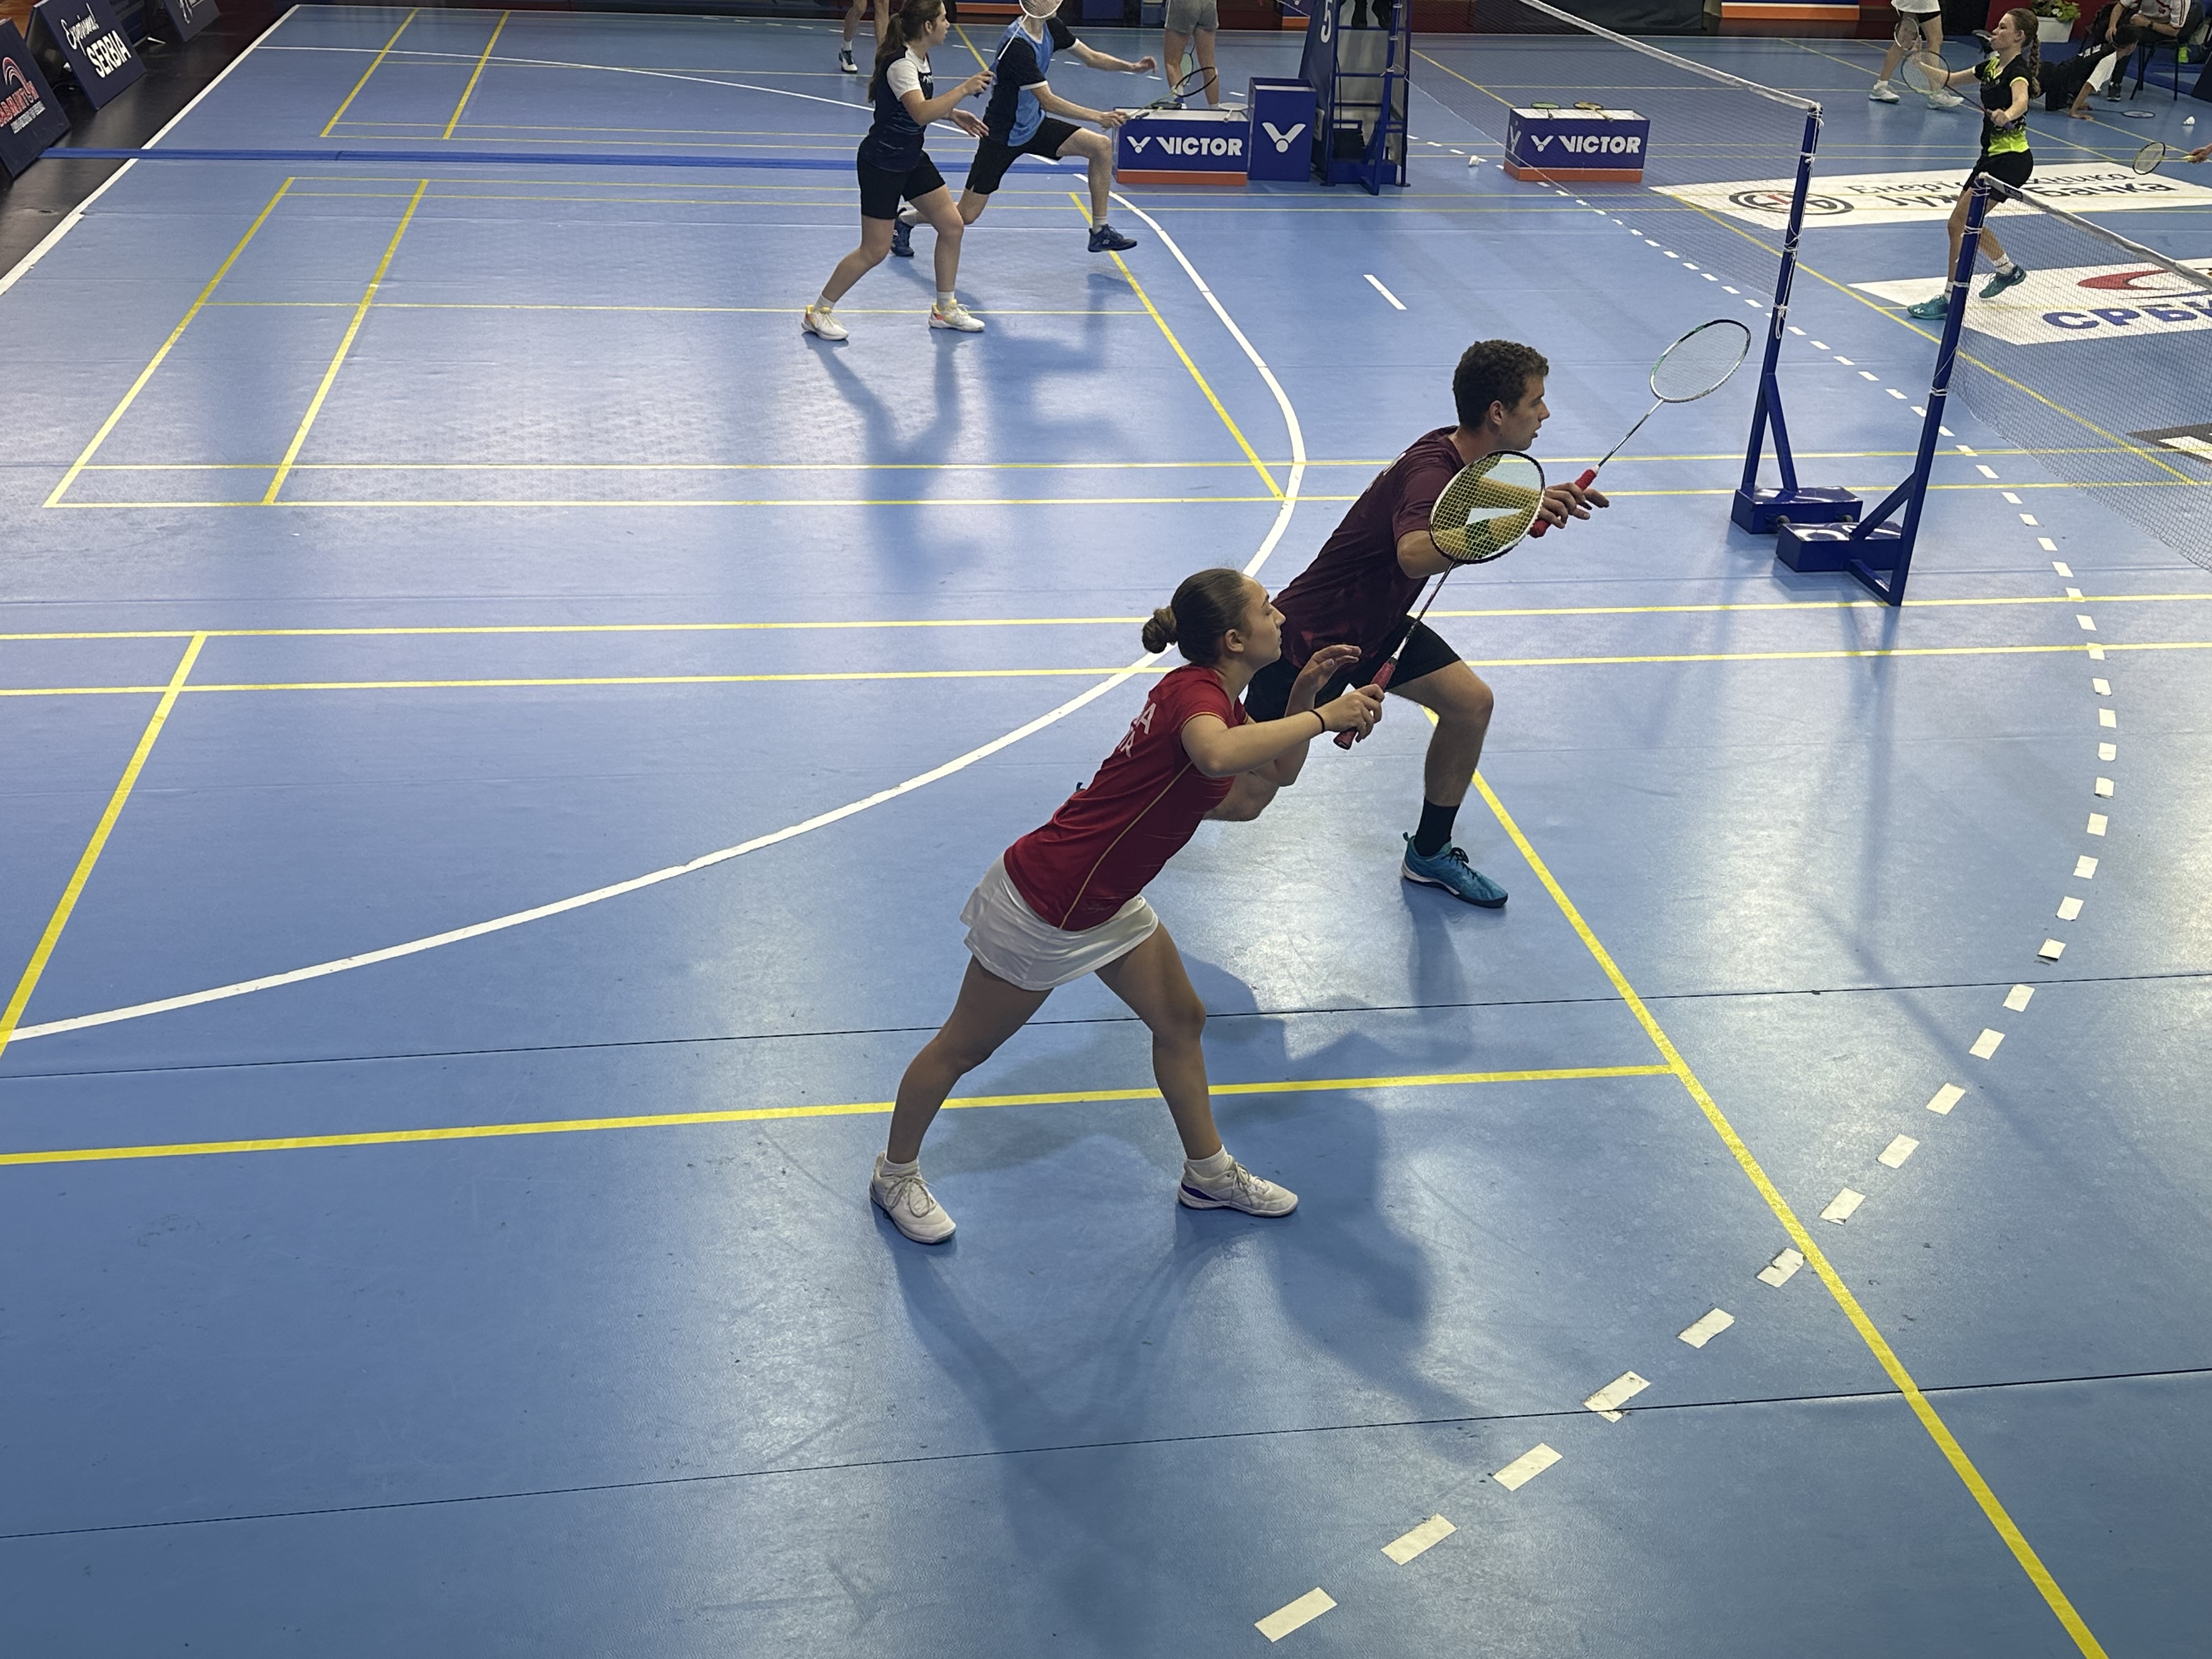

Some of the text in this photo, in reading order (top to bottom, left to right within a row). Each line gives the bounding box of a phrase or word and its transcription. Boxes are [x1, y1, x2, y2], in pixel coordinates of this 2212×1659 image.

[86, 30, 132, 78] SERBIA
[1156, 136, 1243, 156] VICTOR
[1558, 135, 1641, 154] VICTOR
[2021, 182, 2180, 198] Бачка
